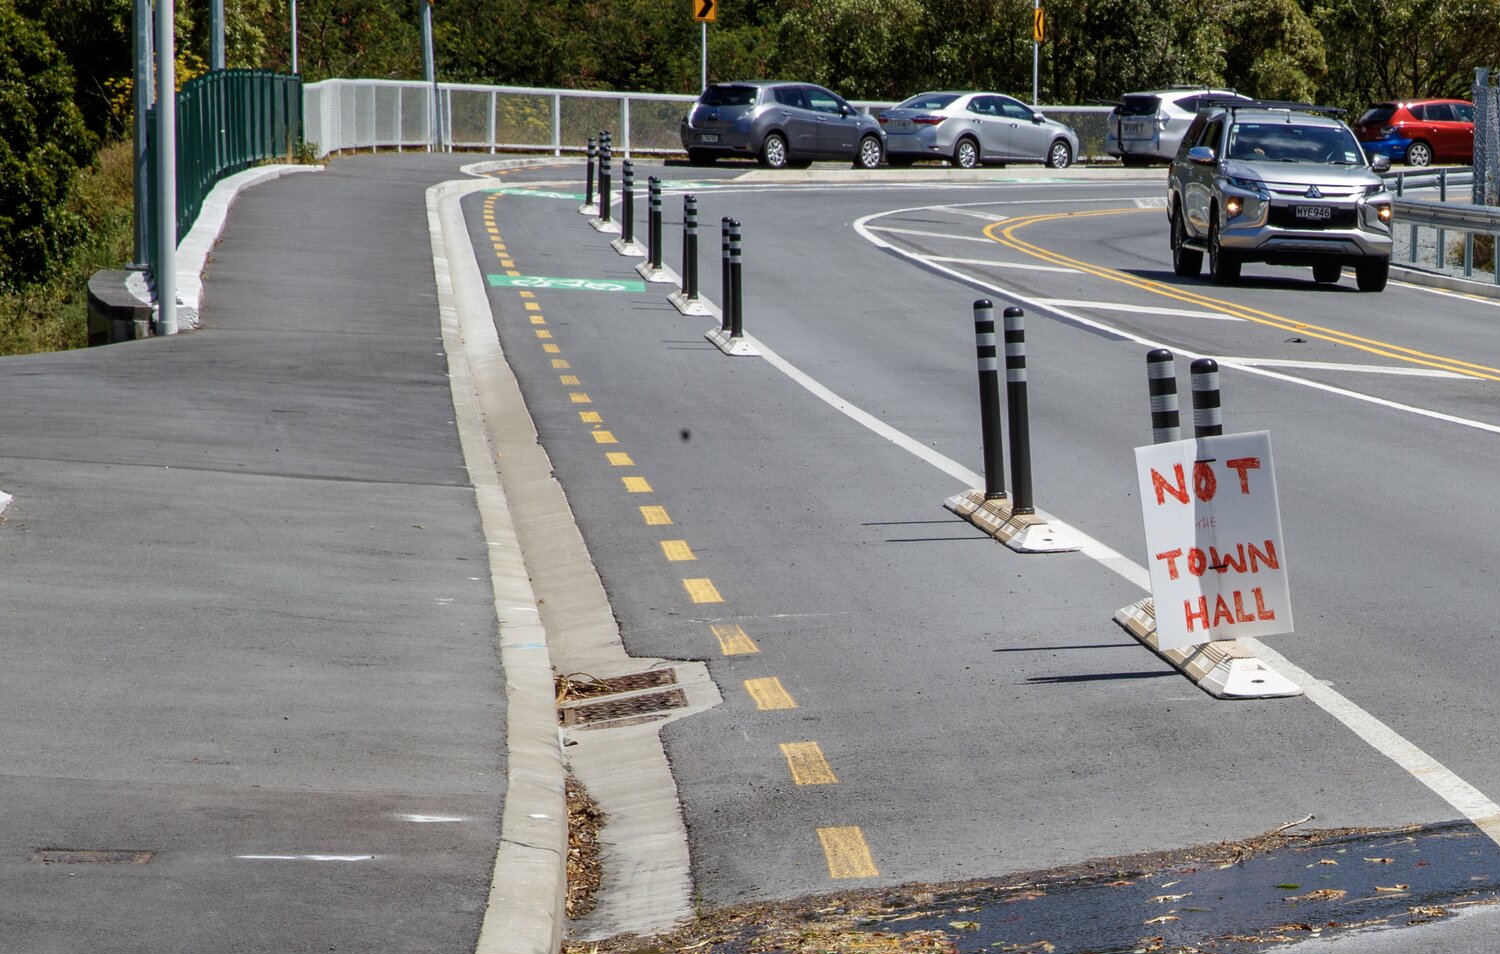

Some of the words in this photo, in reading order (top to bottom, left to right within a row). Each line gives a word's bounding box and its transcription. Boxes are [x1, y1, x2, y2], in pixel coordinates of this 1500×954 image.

[1296, 206, 1330, 217] MYE946
[1150, 457, 1261, 505] NOT
[1195, 516, 1217, 529] THE
[1156, 539, 1280, 580] TOWN
[1184, 586, 1275, 632] HALL
